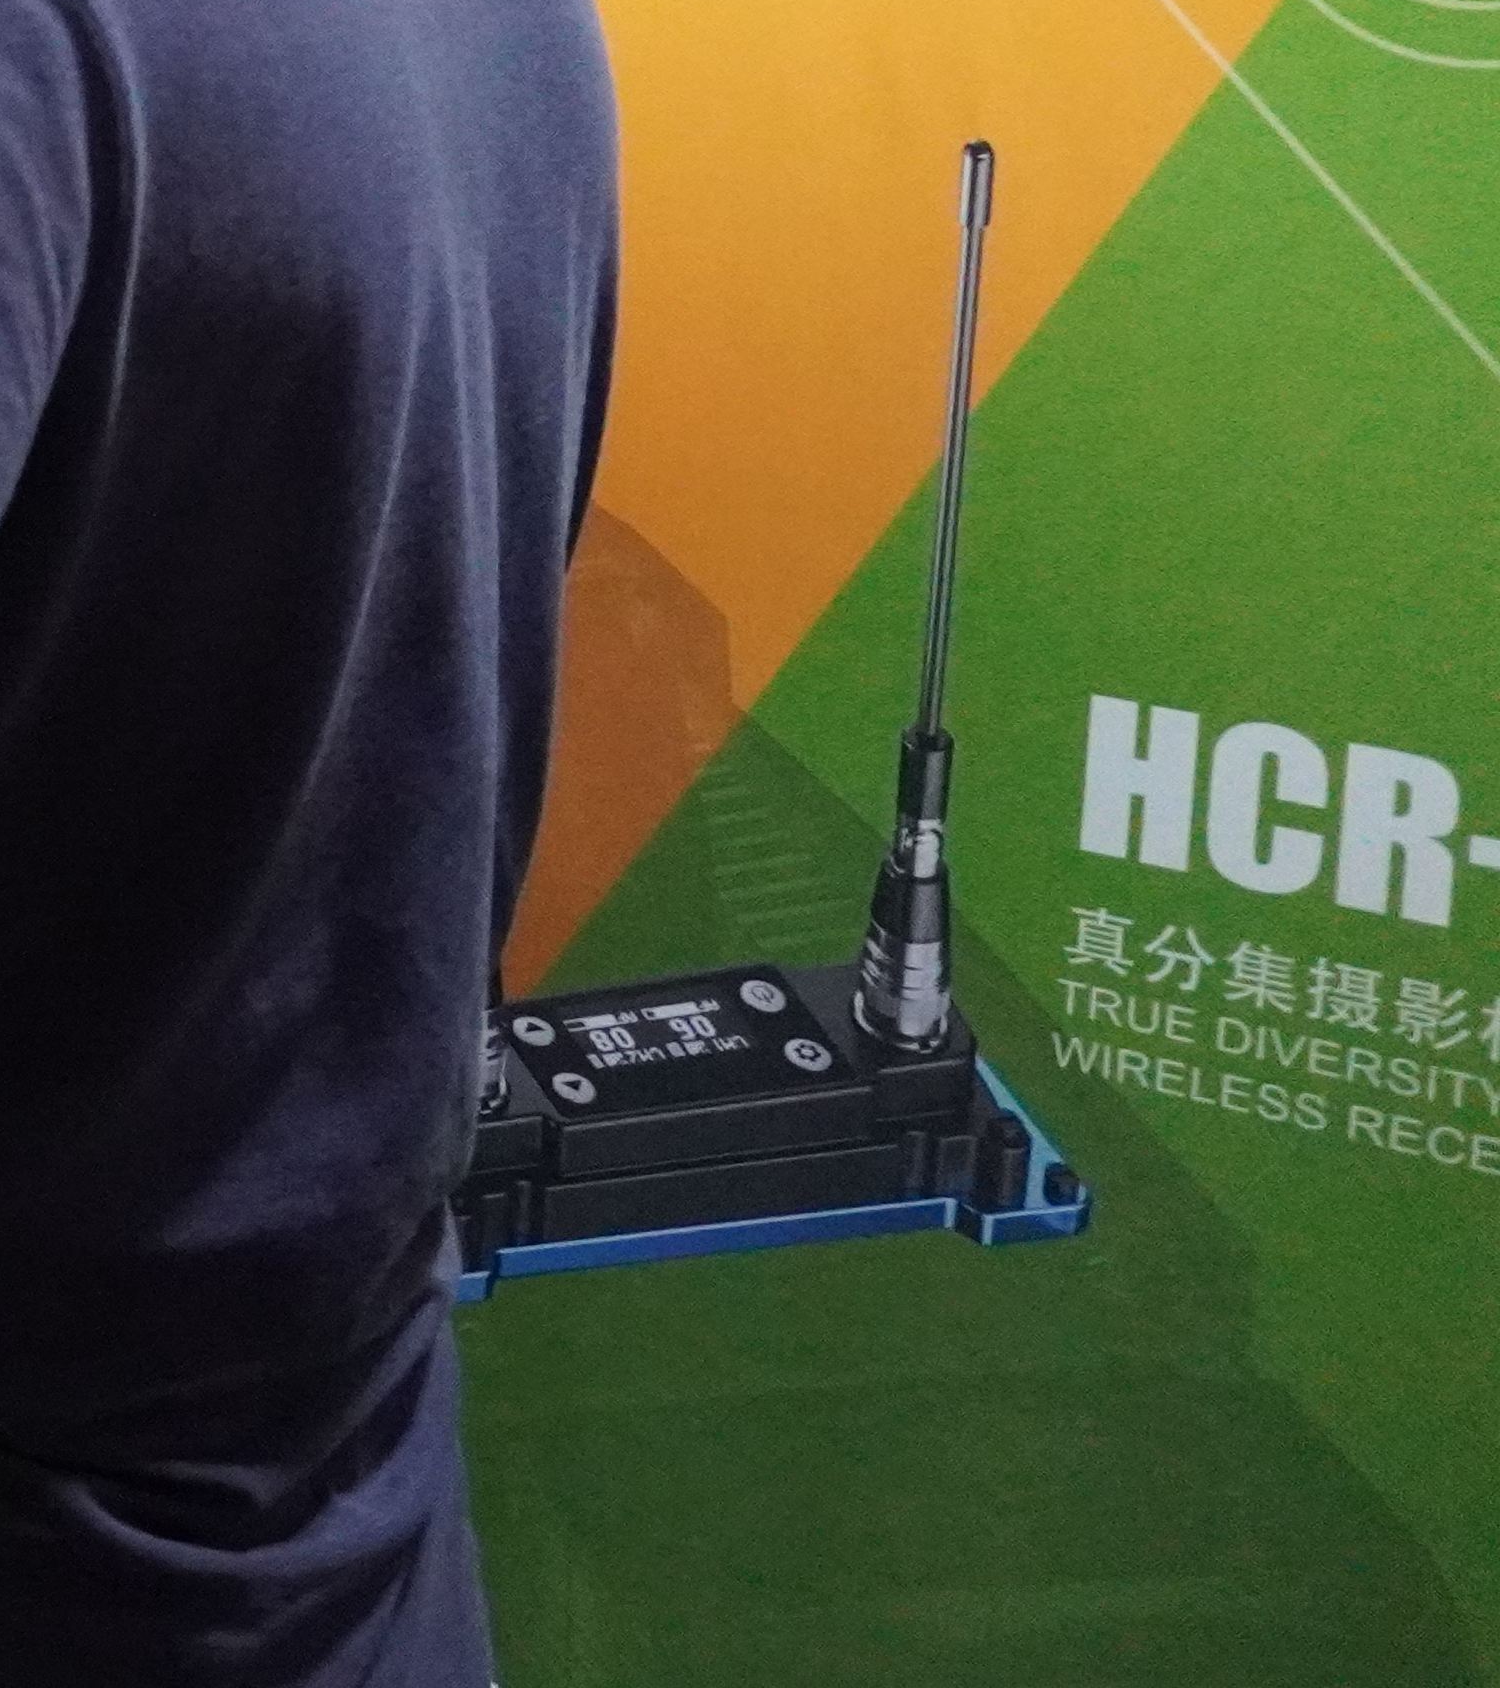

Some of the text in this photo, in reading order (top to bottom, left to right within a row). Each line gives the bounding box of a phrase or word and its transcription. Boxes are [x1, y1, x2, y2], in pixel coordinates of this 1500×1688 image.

[667, 1014, 717, 1041] 90
[1057, 977, 1197, 1044] TRUE
[1051, 1031, 1328, 1131] WIRELESS
